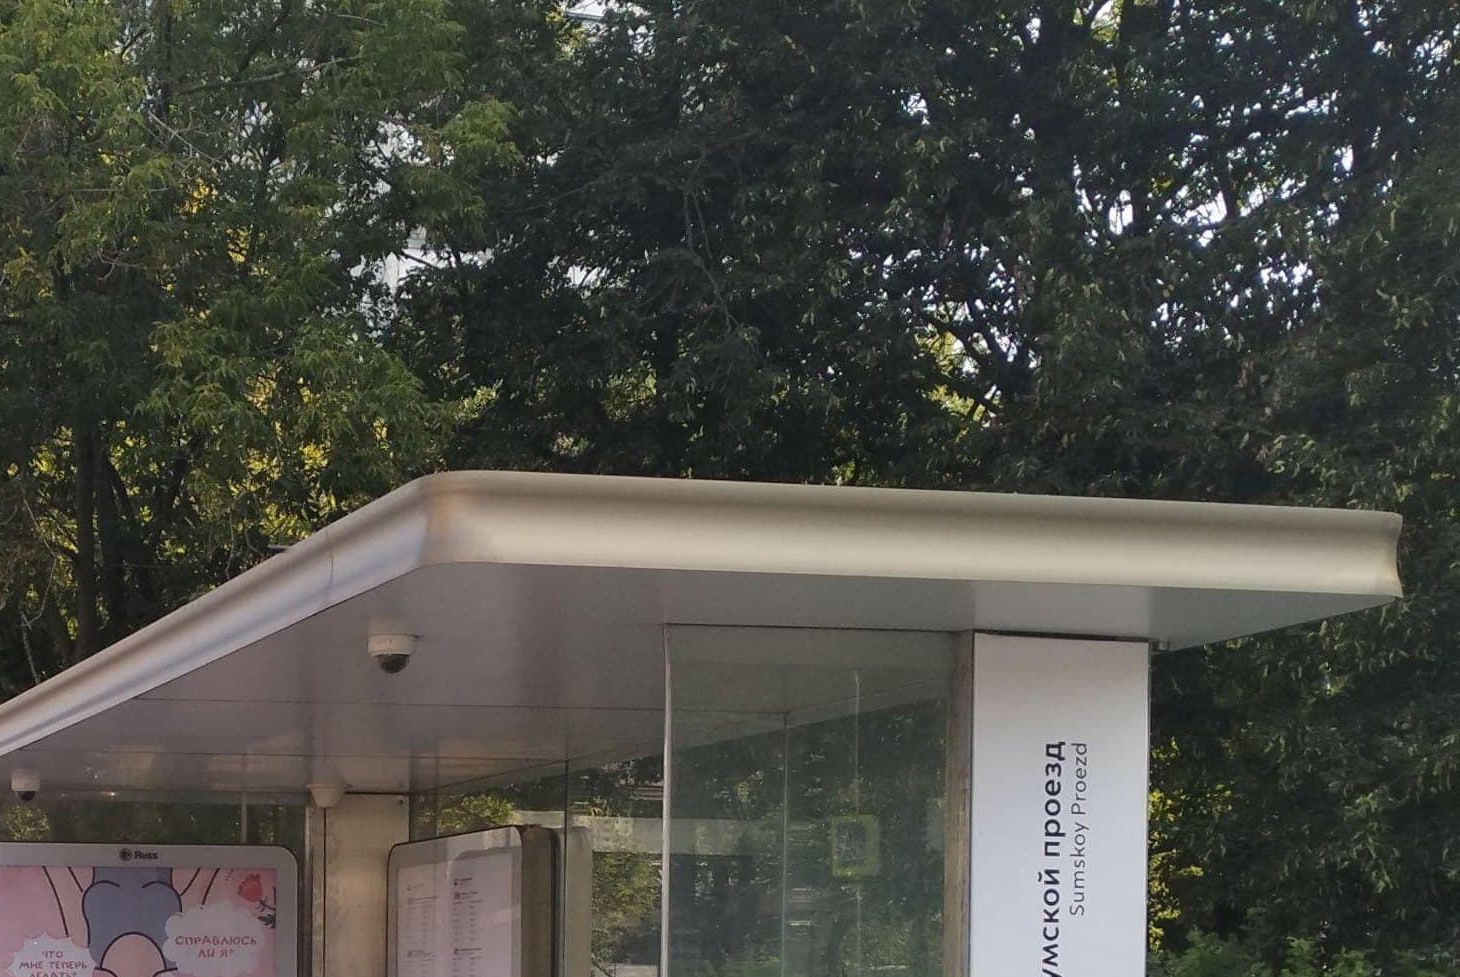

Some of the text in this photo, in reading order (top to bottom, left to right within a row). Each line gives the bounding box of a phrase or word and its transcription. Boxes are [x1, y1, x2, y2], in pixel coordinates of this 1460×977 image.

[1044, 740, 1066, 858] проезд
[1070, 742, 1090, 916] Sumskoy Proezd
[175, 934, 258, 947] СПРАВЛЮСЬ
[42, 950, 64, 959] ЧТО
[197, 947, 234, 959] ЛИ Я?
[19, 960, 88, 970] МНЕ ТЕПЕРЬ
